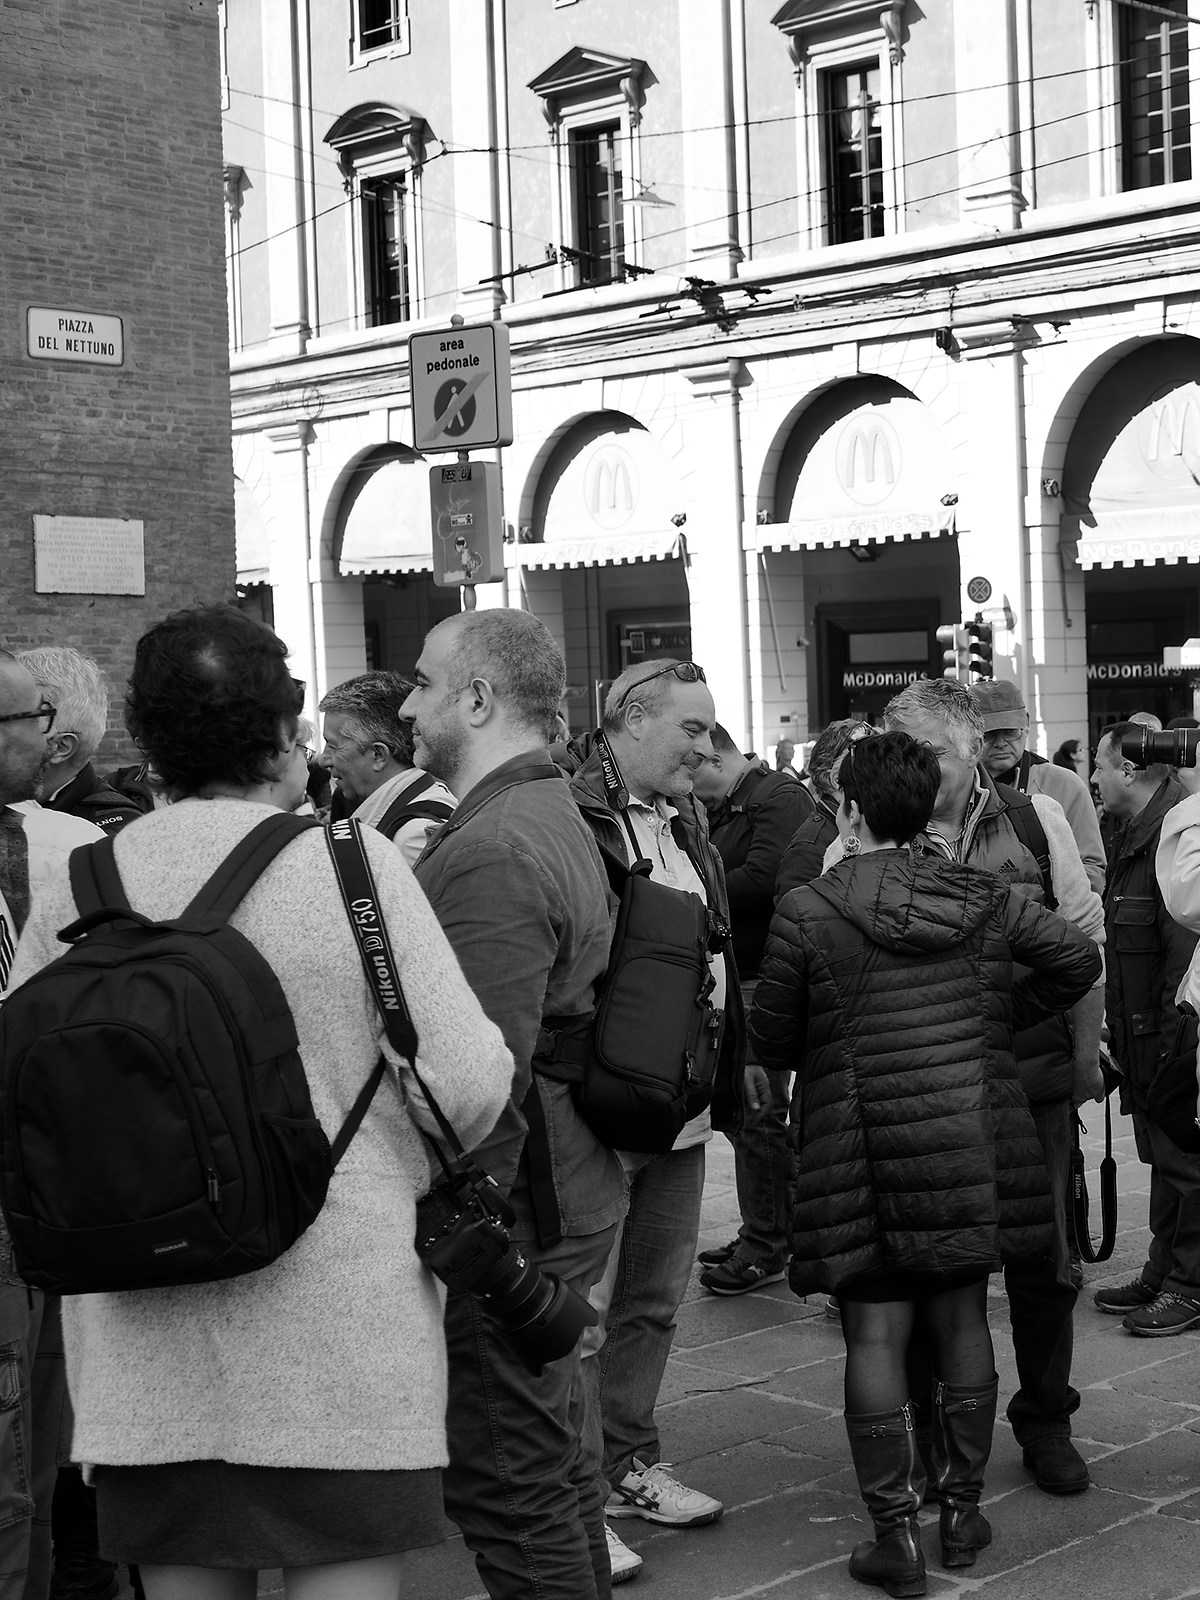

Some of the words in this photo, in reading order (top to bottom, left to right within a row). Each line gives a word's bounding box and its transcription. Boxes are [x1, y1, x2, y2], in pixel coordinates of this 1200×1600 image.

[58, 318, 94, 334] PIAZZA
[38, 335, 59, 350] DEL
[65, 338, 115, 356] NETTUNO
[439, 339, 465, 352] area
[426, 353, 480, 375] pedonale
[602, 760, 619, 789] Nikon
[350, 898, 385, 953] D750
[373, 954, 400, 1011] Nikon
[1074, 1173, 1082, 1199] Nikon
